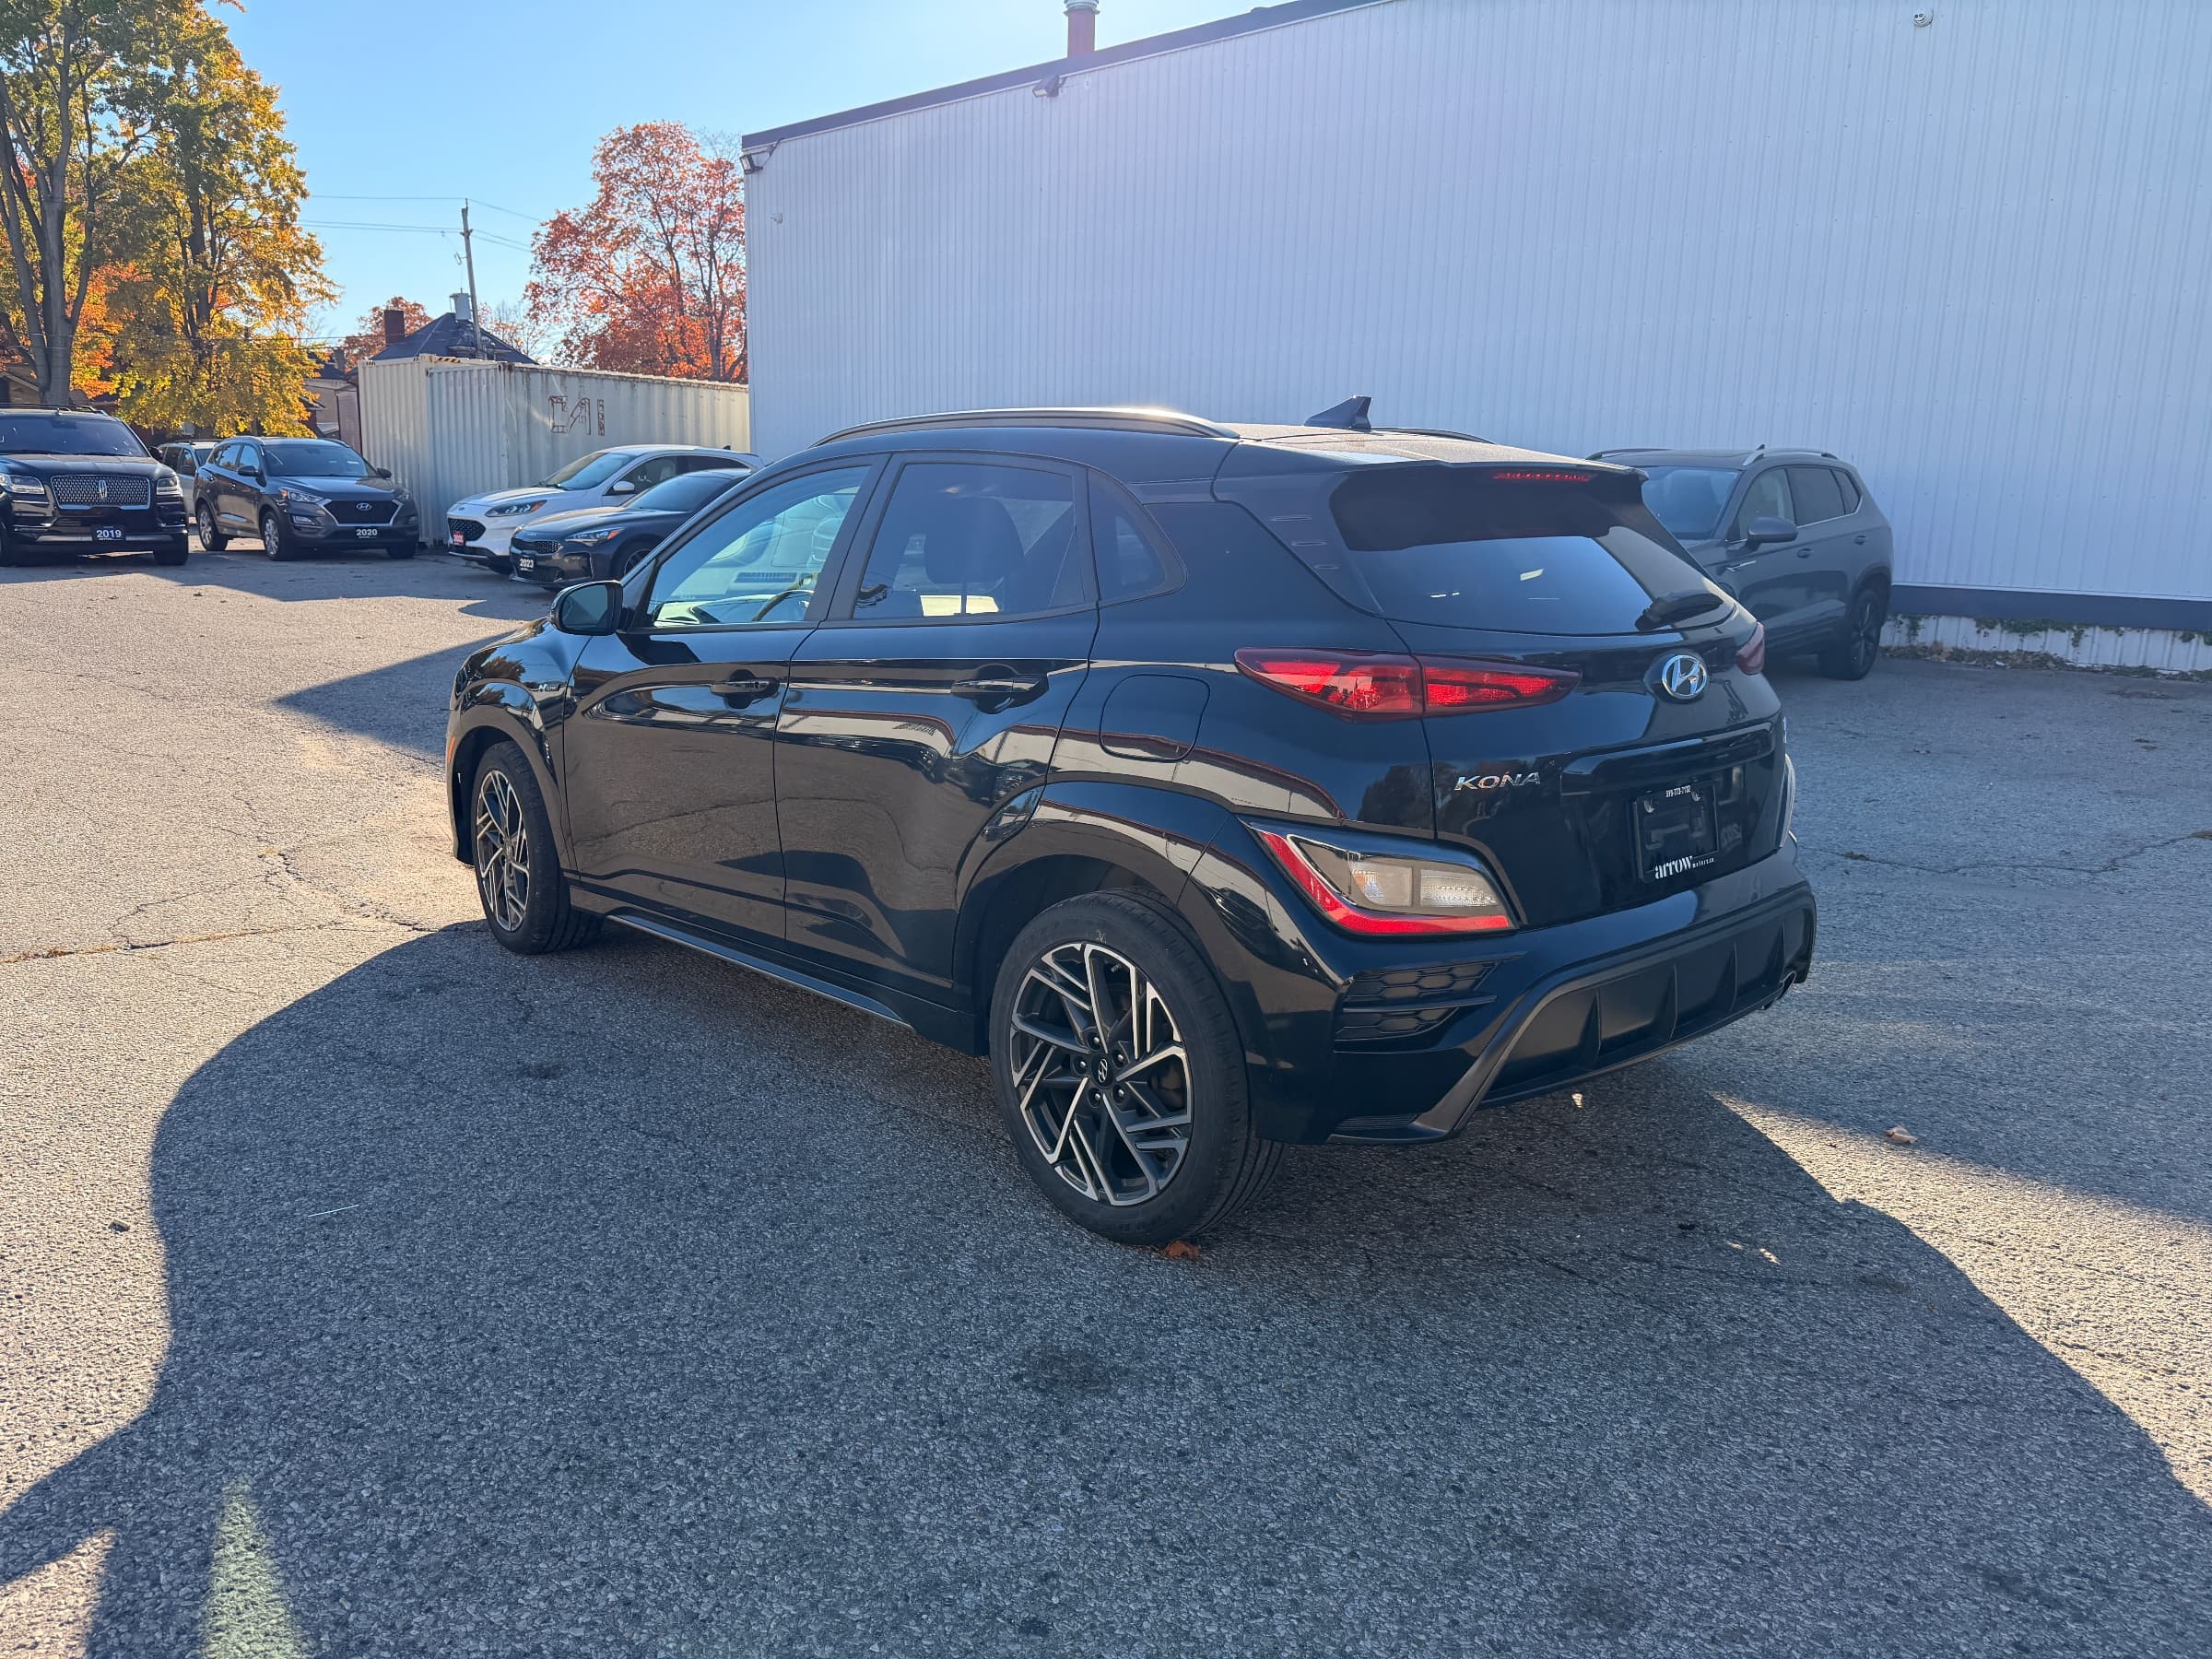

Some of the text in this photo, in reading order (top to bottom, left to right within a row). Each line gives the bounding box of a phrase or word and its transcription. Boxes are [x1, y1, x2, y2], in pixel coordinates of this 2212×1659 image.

[96, 529, 122, 538] 2019
[356, 528, 378, 536] 2020
[519, 558, 534, 569] 2023
[1453, 771, 1541, 791] KONA
[1654, 855, 1693, 879] arrow
